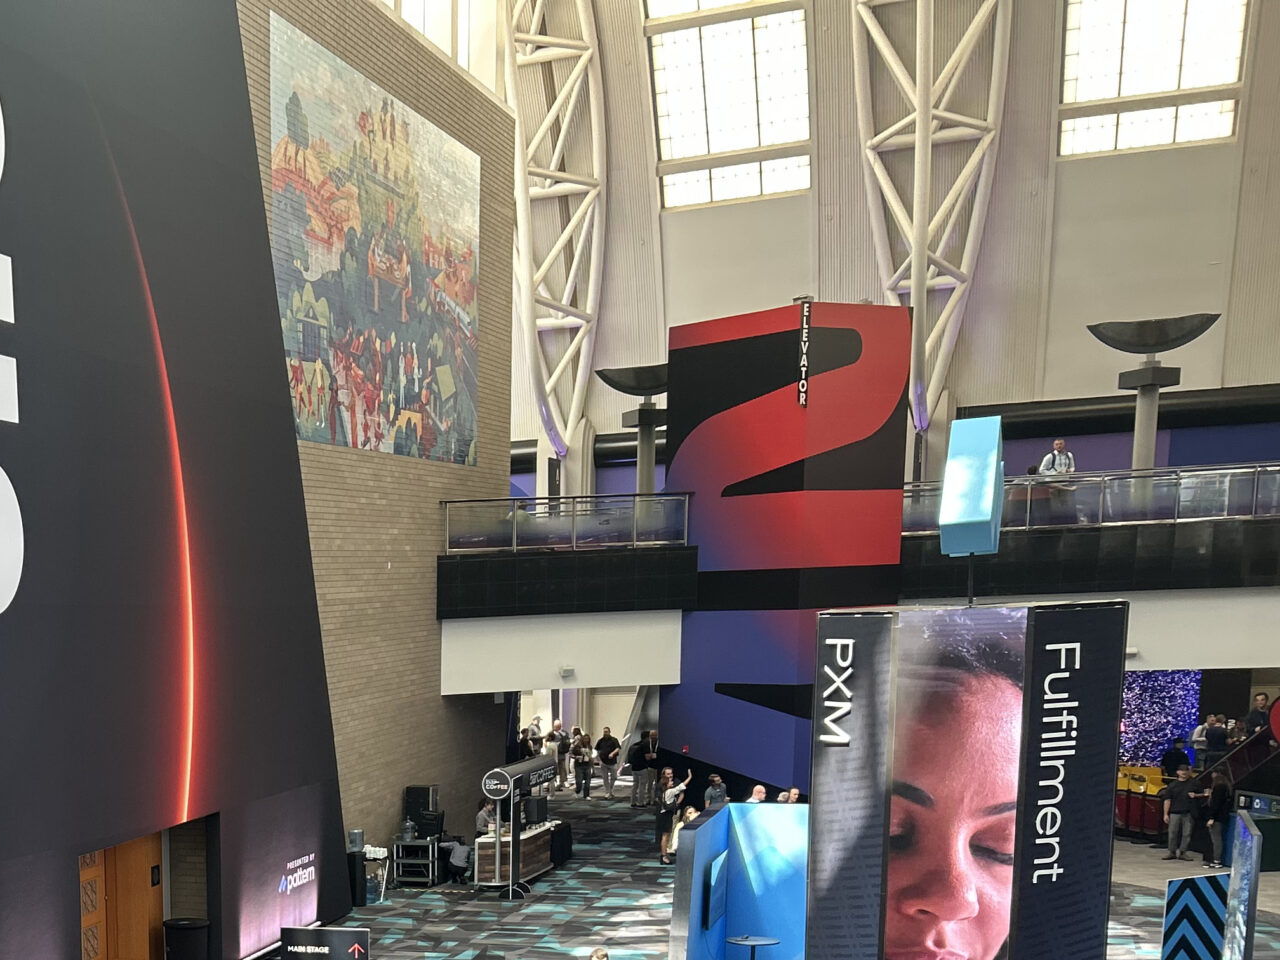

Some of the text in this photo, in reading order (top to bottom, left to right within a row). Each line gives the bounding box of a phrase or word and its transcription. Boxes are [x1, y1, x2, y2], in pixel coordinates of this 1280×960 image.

[799, 303, 809, 405] ELEVATOR
[819, 638, 856, 745] PXM
[1032, 642, 1081, 884] Fulfillment
[287, 866, 315, 895] pattern
[287, 945, 329, 954] MAIN STAGE
